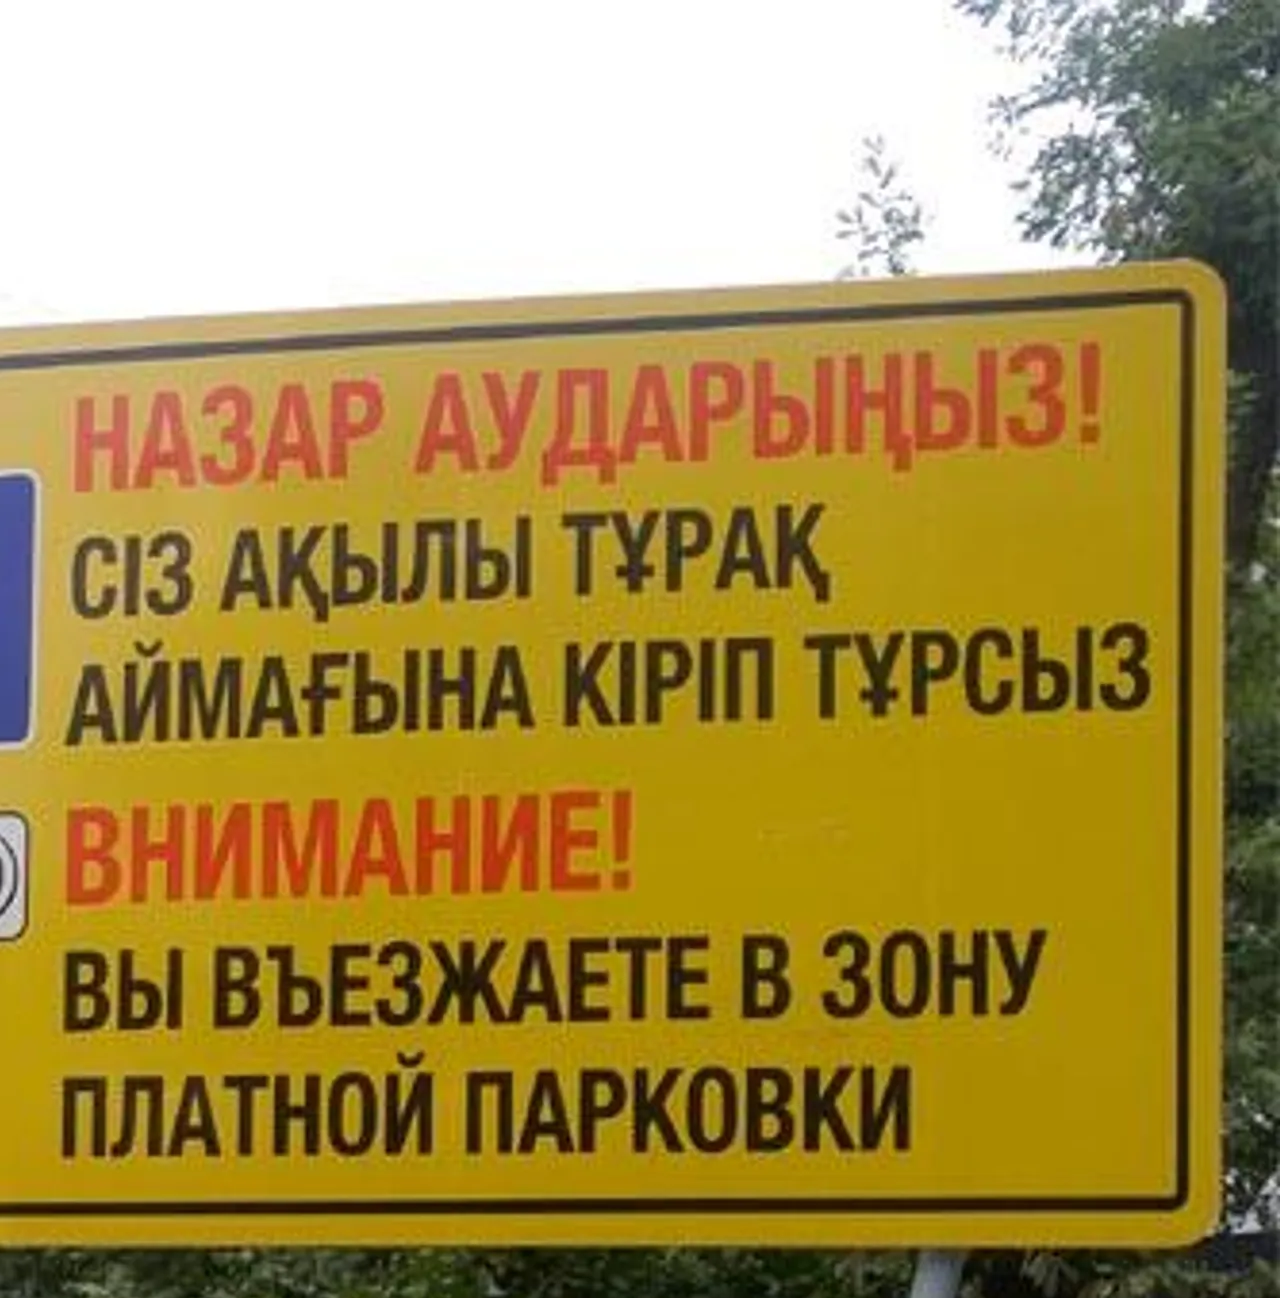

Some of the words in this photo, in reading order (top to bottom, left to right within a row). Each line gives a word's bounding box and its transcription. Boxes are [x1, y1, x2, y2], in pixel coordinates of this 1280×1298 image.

[77, 381, 383, 491] НАЗАР
[415, 342, 1100, 486] АУДАРЫҢЫЗ!
[74, 534, 191, 617] СІЗ
[222, 518, 530, 621] АҚЫЛЫ
[563, 504, 829, 602] ТҰРАҚ
[67, 643, 534, 745] АЙМАҒЫНА
[565, 638, 773, 726] КІРІП
[804, 623, 1150, 718] ТҰРСЫЗ
[66, 790, 632, 905] ВНИМАНИЕ!
[64, 949, 182, 1032] ВЫ
[214, 937, 709, 1028] ВЪЕЗЖАЕТЕ
[742, 935, 791, 1018] В
[822, 930, 1047, 1018] ЗОНУ
[63, 1052, 432, 1157] ПЛАТНОЙ
[466, 1066, 910, 1154] ПАРКОВКИ
